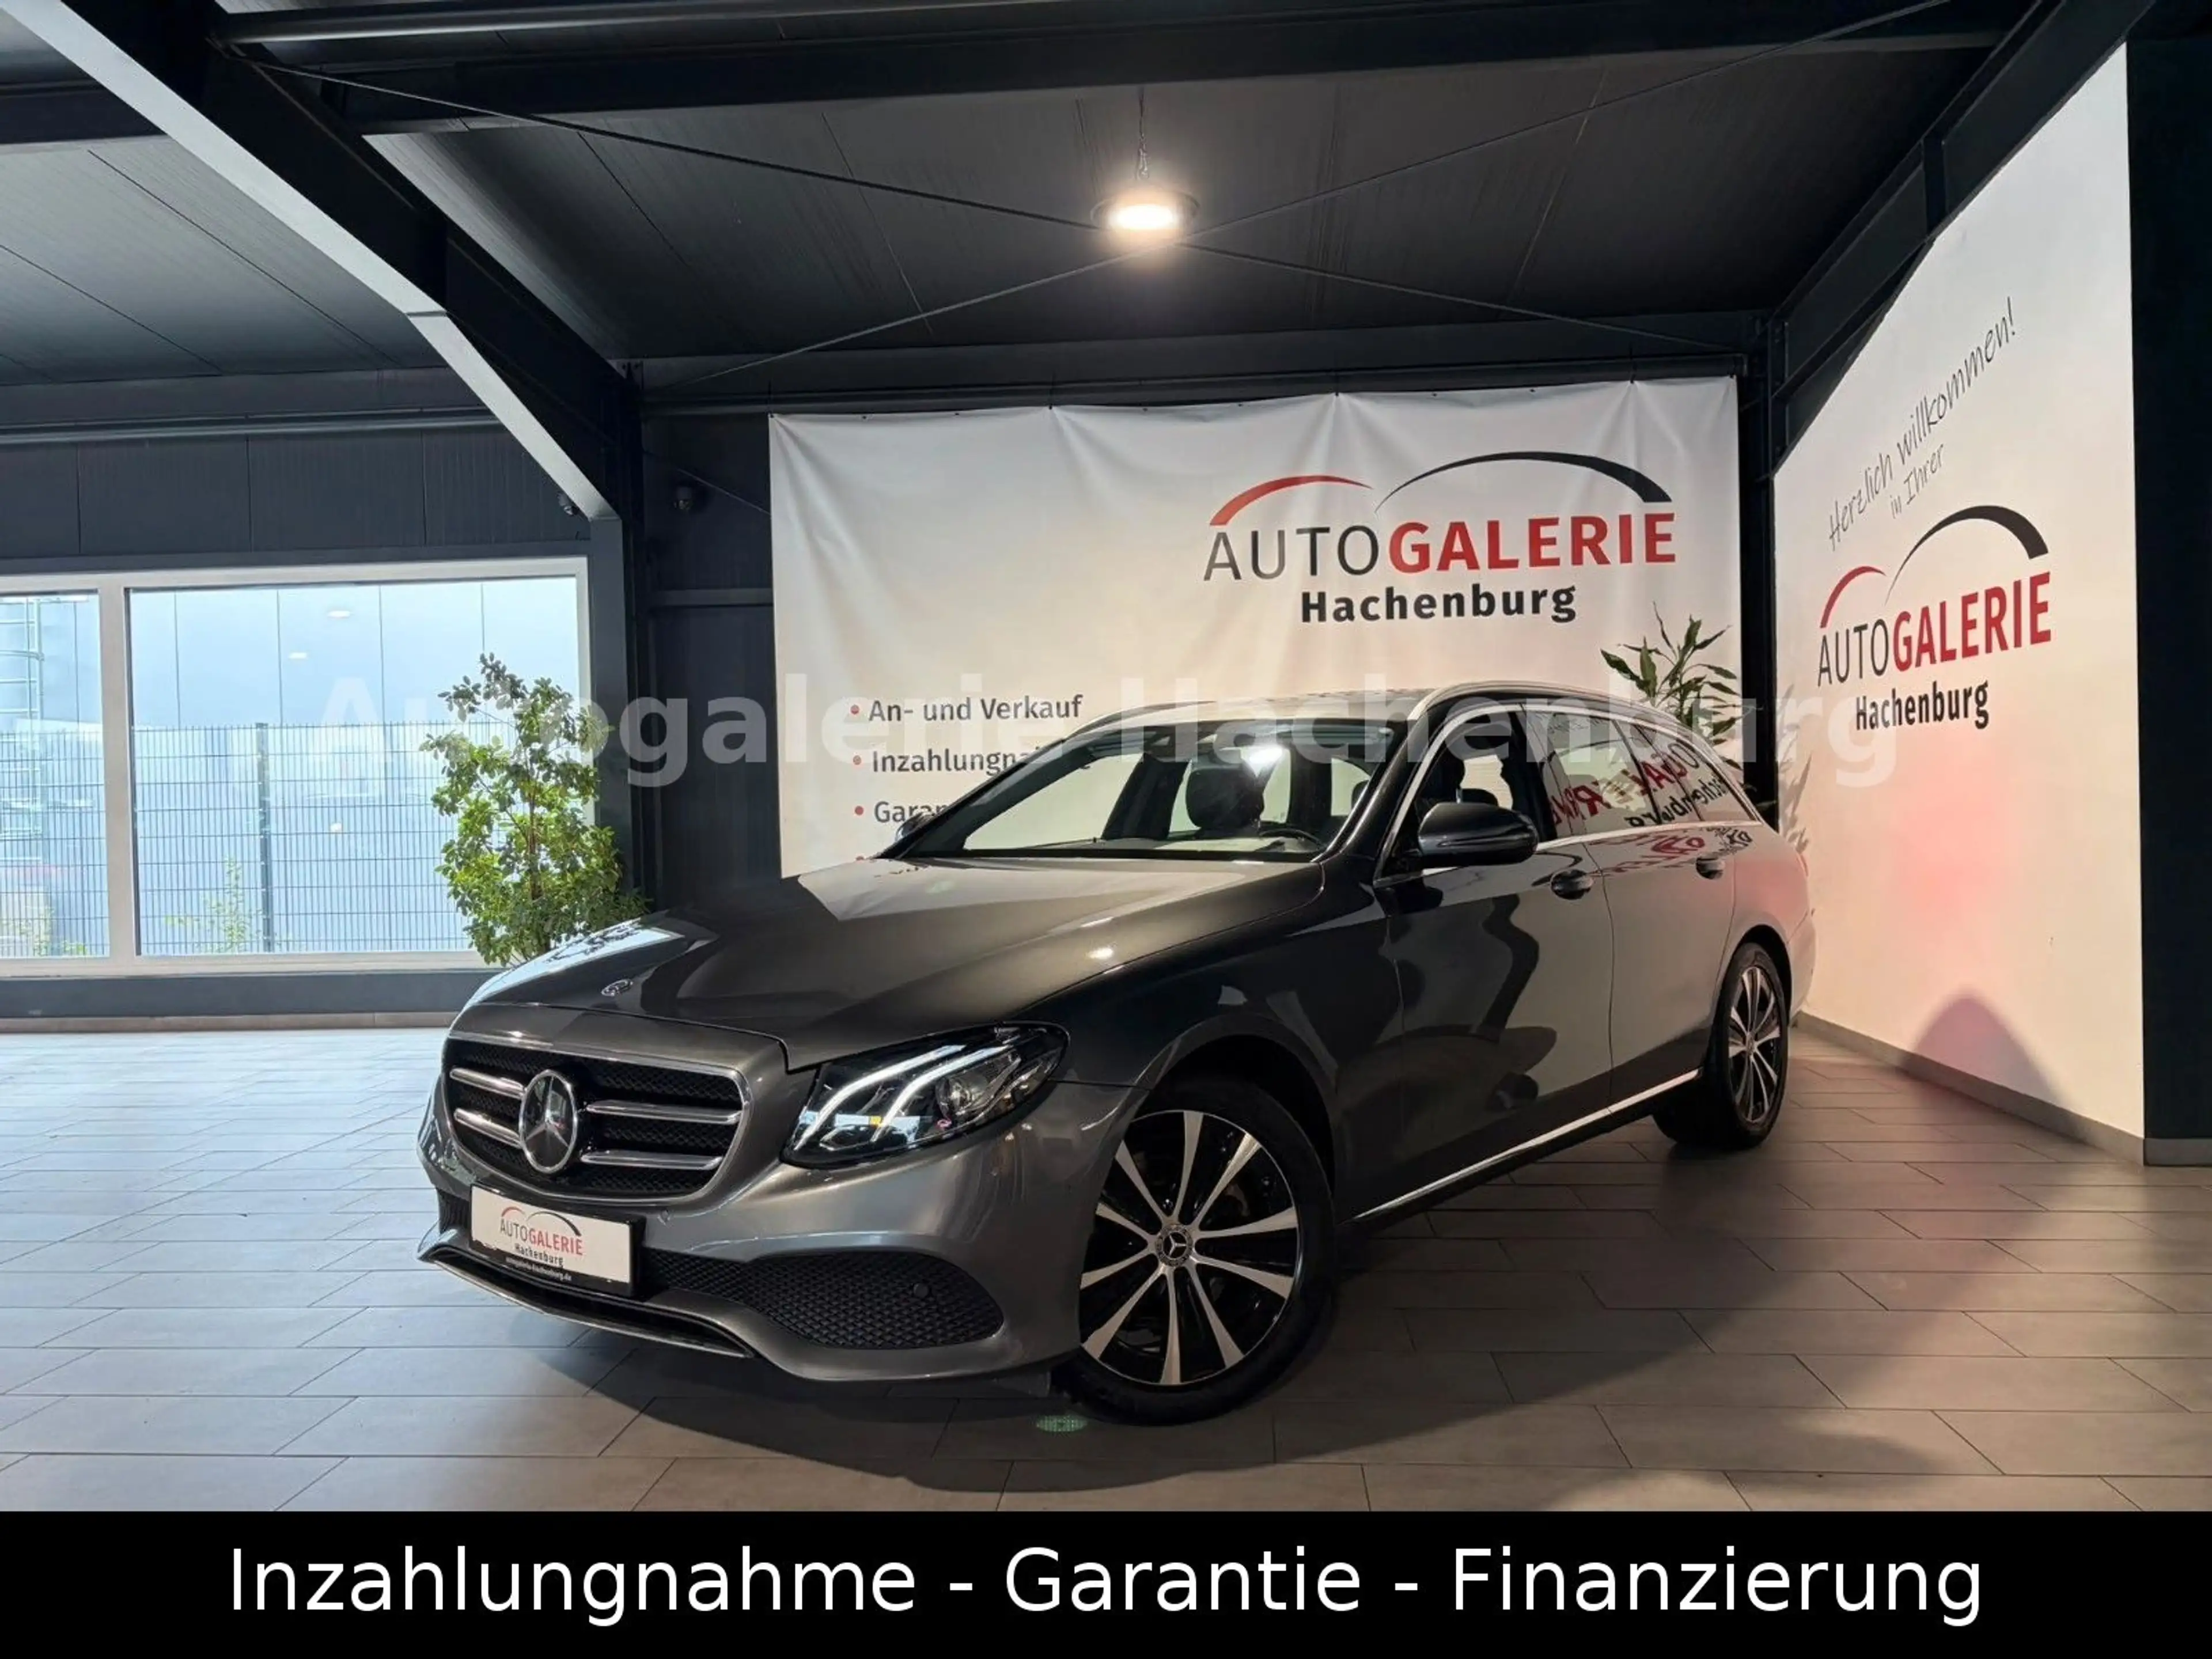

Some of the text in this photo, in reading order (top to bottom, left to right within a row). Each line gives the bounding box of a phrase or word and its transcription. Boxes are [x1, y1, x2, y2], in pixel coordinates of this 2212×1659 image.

[1828, 296, 2016, 551] Herzlich willkommen!
[1889, 444, 1944, 520] in Ihrer
[1203, 512, 1676, 582] AUTOGALERIE
[1301, 584, 1577, 623] Hachenburg
[1817, 570, 2052, 687] AUTOGALERIE
[869, 694, 1084, 722] An- und Verkauf
[1855, 680, 1989, 730] Hachenburg
[873, 747, 1090, 776] Inzahlungn
[499, 1218, 584, 1256] AUTOGALERIE
[514, 1243, 564, 1268] Hachenburg
